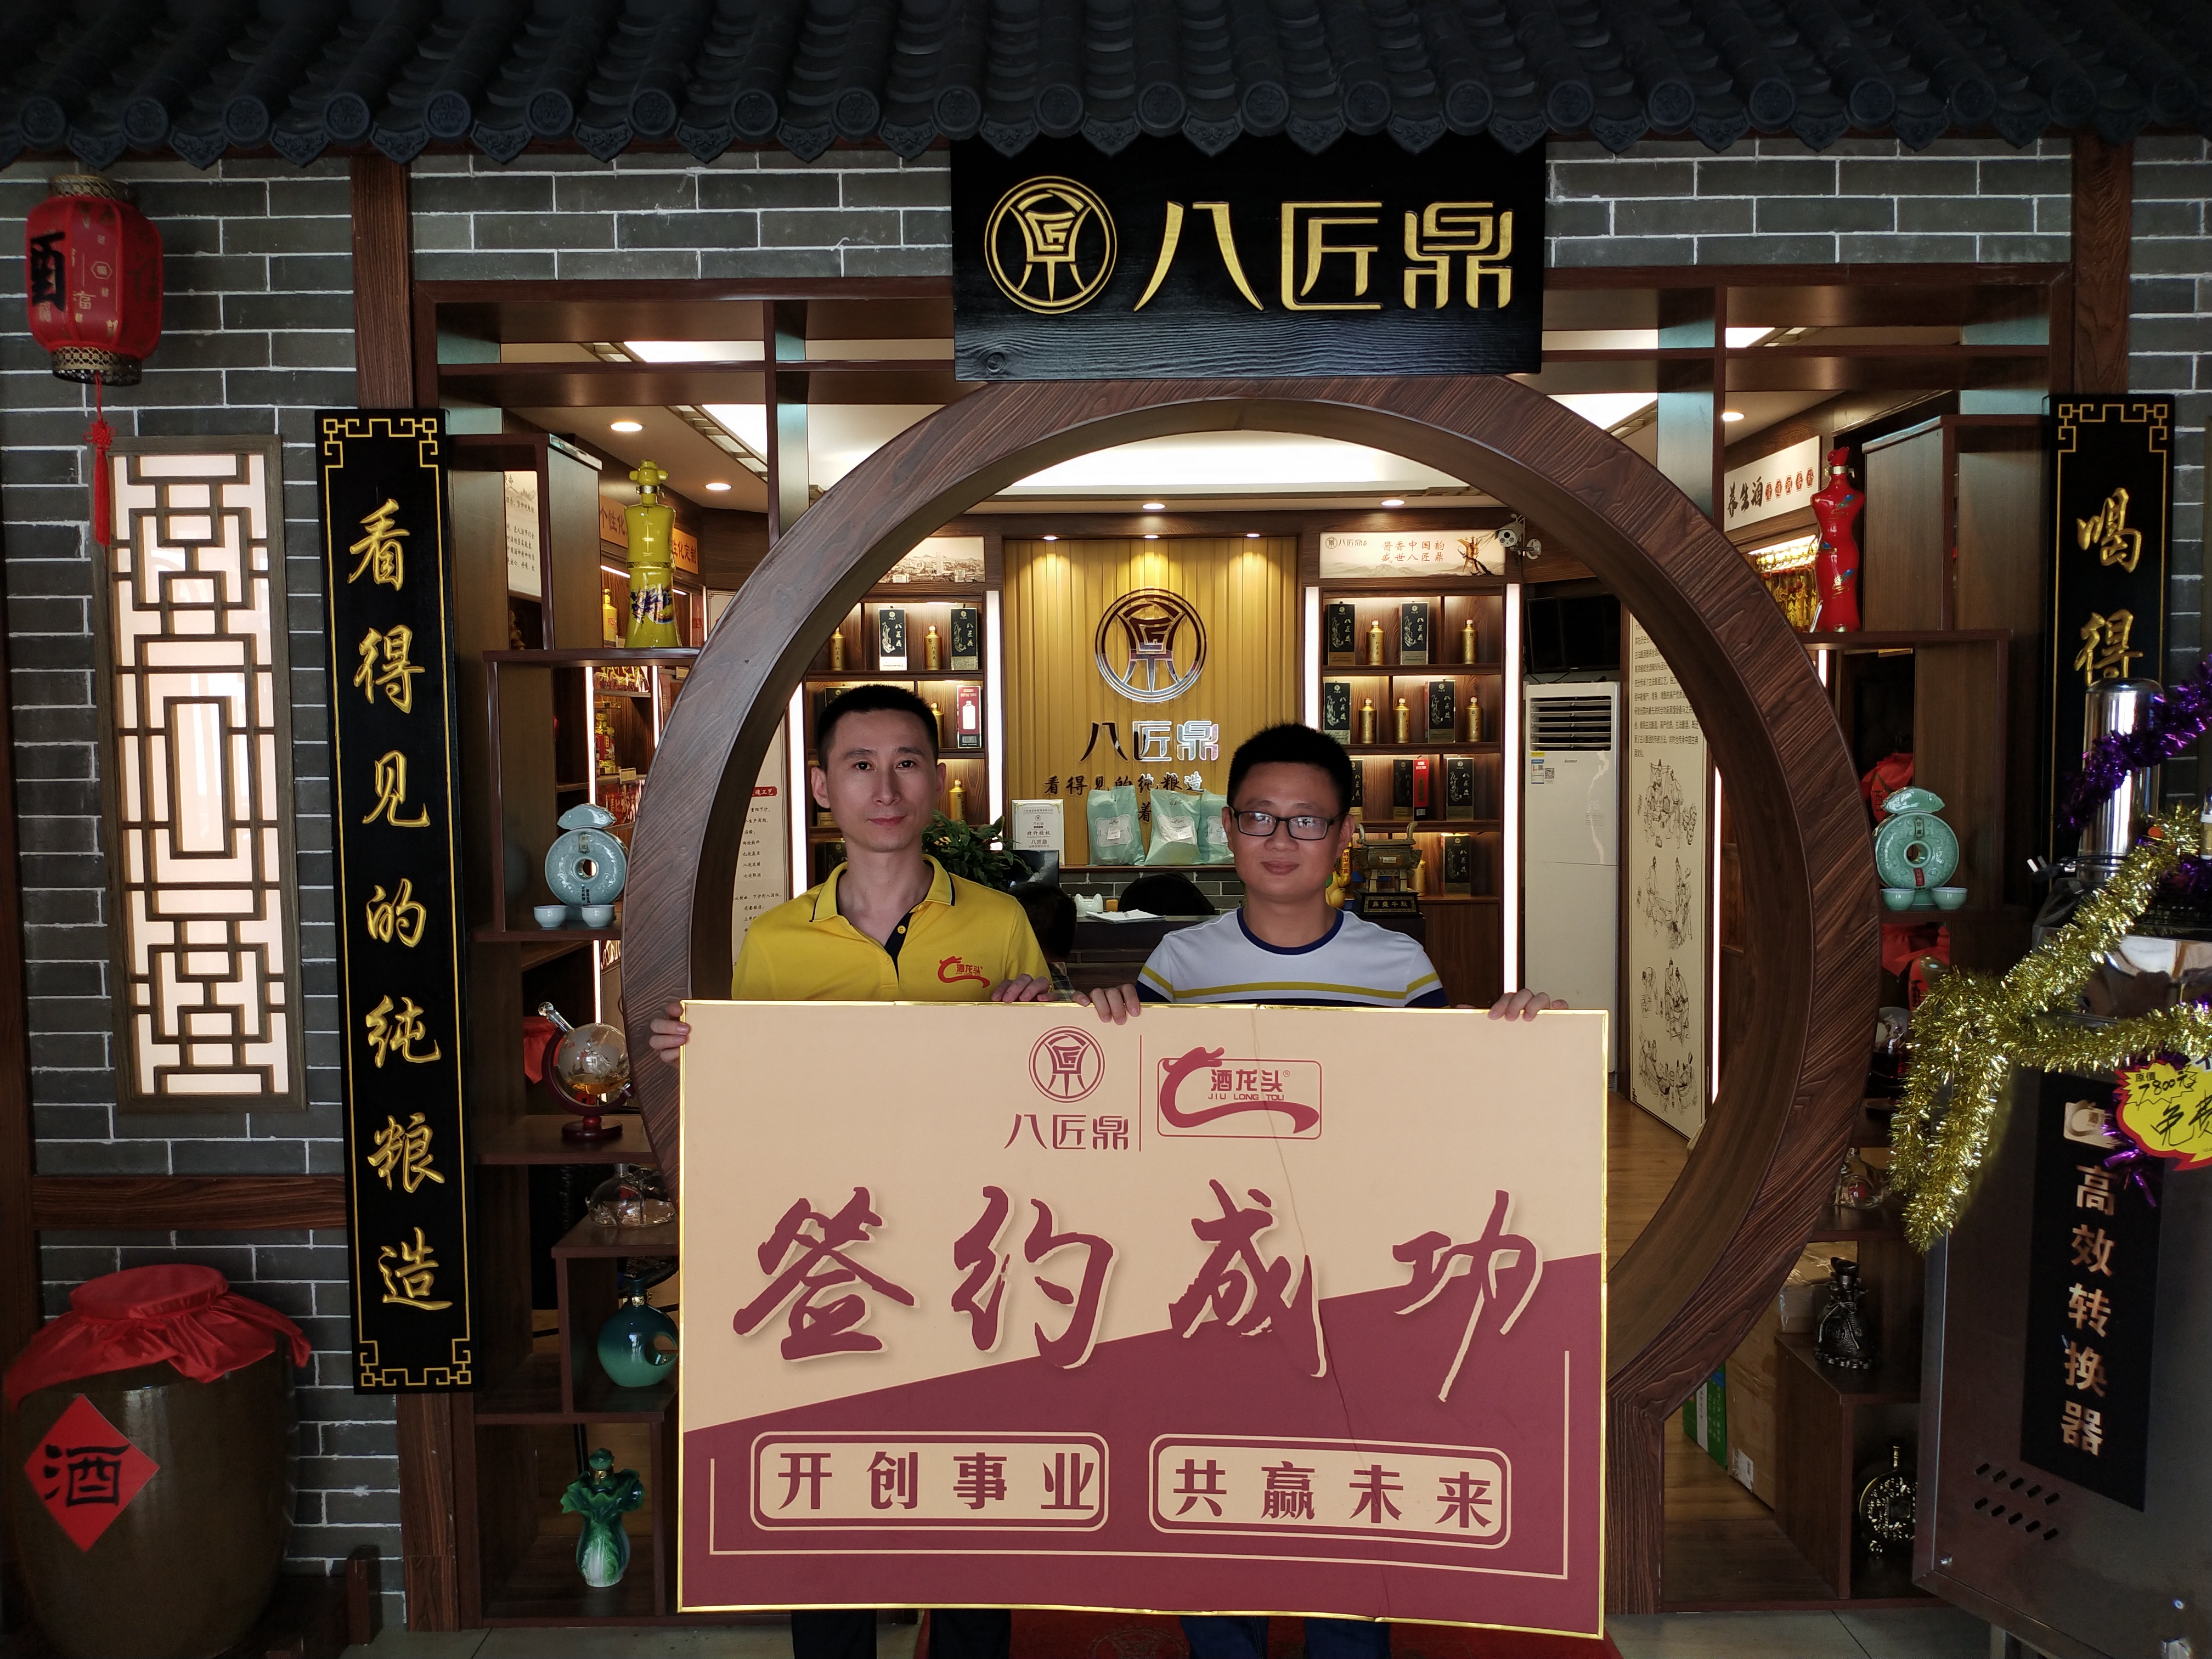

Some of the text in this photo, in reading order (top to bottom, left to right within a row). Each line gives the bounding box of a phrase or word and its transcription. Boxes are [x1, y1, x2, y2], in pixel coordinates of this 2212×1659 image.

[1133, 200, 1514, 313] 八匠鼎
[1079, 720, 1220, 763] 八匠鼎
[347, 498, 453, 1311] 看得见的纯粮造
[1210, 1069, 1283, 1093] 酒龙头
[1233, 1093, 1260, 1101] LONG
[1265, 1093, 1285, 1102] TOU
[1003, 1113, 1128, 1150] 八匠鼎
[732, 1180, 1545, 1402] 签约成功
[2060, 1164, 2118, 1458] 高效转换器
[44, 1443, 132, 1508] 酒
[776, 1449, 1096, 1512] 开创事业
[1172, 1458, 1494, 1528] 共赢未来
